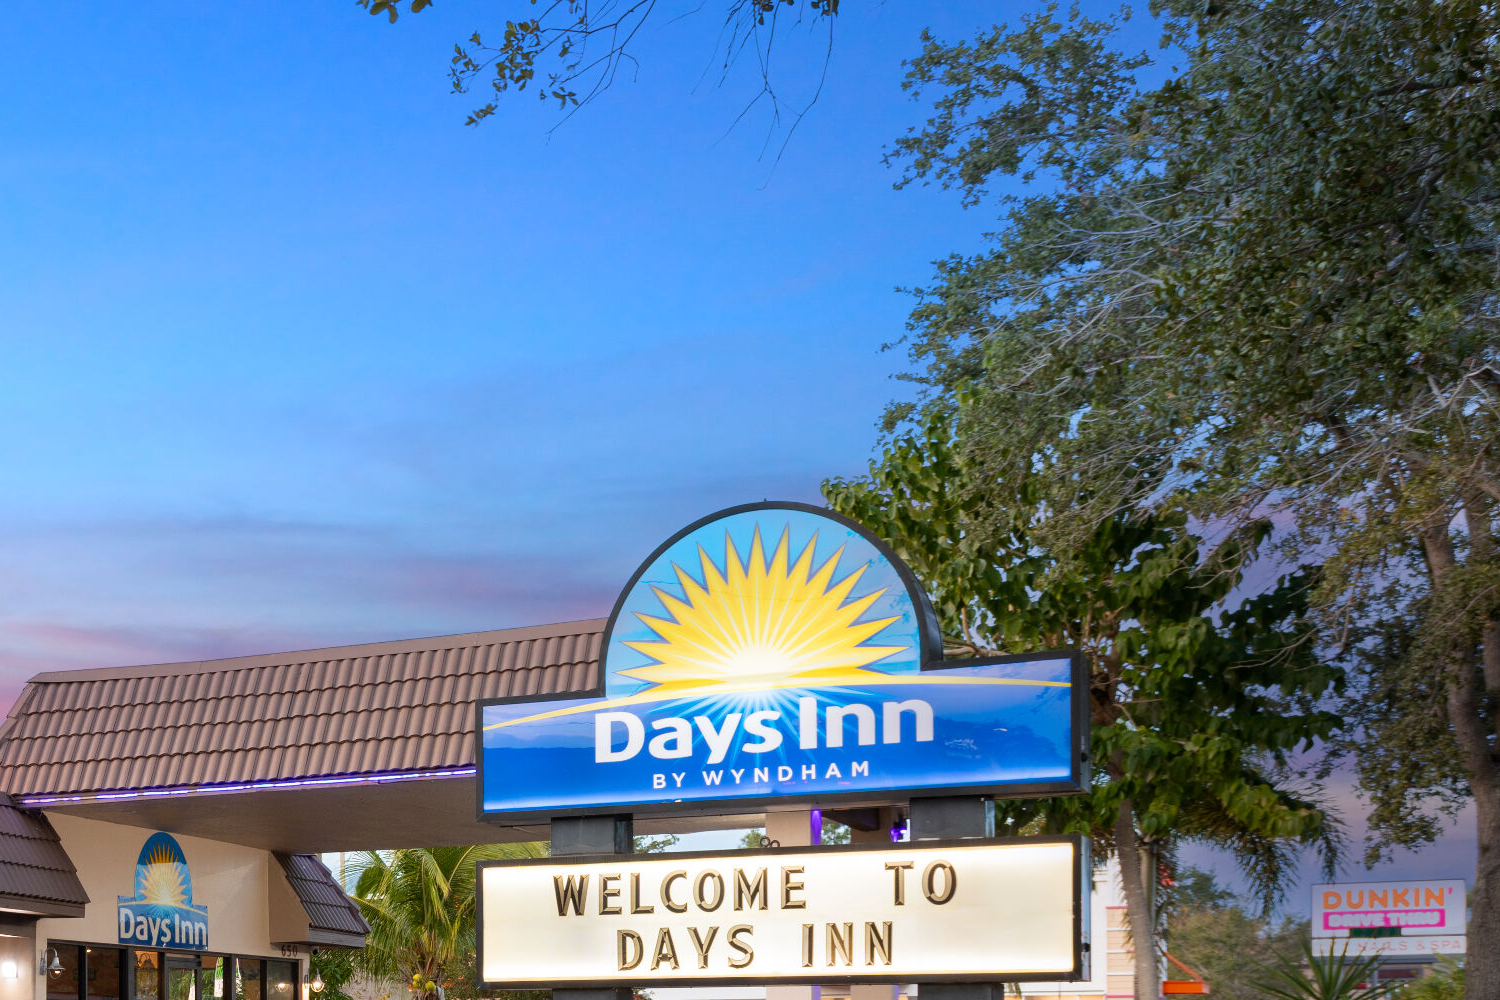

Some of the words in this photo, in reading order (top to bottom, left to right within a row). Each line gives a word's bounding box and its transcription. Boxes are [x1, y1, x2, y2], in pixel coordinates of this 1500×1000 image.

[595, 710, 783, 764] Days
[799, 697, 934, 750] Inn
[652, 772, 686, 789] BY
[702, 760, 869, 786] WYNDHAM
[553, 865, 806, 916] WELCOME
[884, 859, 958, 906] TO
[1323, 886, 1453, 910] DUNKIN'
[119, 907, 172, 946] Days
[174, 913, 207, 946] Inn
[1328, 912, 1385, 927] DRIVE
[1386, 911, 1440, 926] THRU
[281, 944, 298, 957] 650
[616, 923, 755, 972] DAYS
[801, 920, 893, 968] INN
[1430, 939, 1462, 950] SPA
